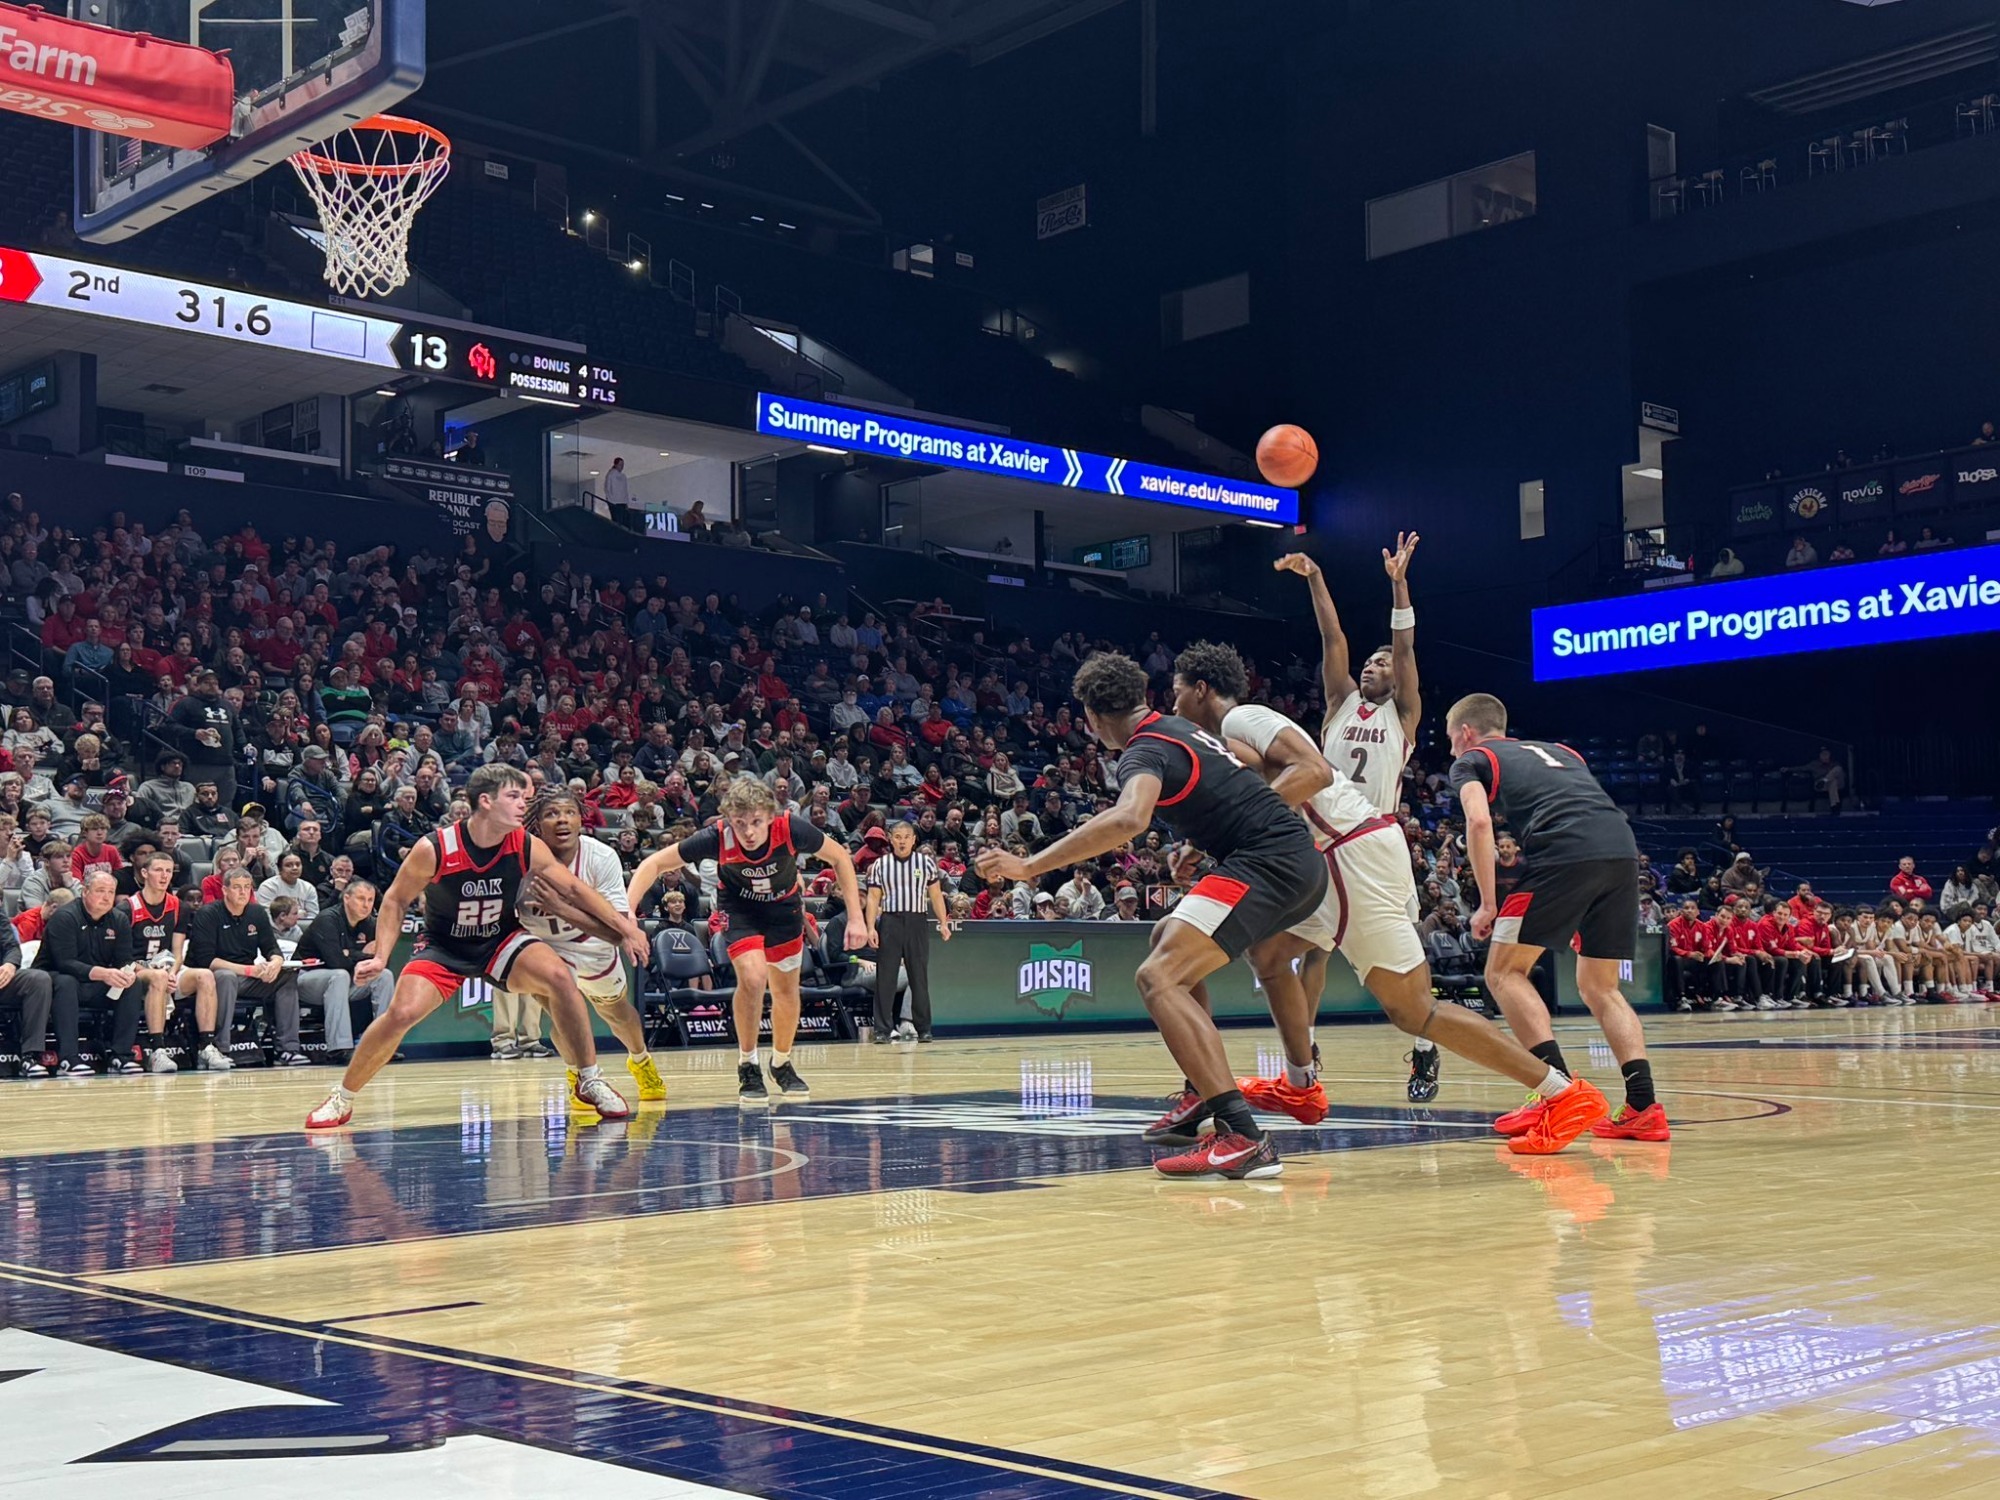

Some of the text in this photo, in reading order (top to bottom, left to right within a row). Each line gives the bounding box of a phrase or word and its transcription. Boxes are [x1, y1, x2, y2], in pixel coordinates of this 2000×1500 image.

[0, 26, 97, 86] Farm
[0, 87, 83, 117] Sta
[68, 269, 120, 301] 2nd
[176, 289, 271, 336] 31.6
[411, 333, 448, 370] 13
[534, 356, 617, 383] BONUS 4 TOL
[510, 372, 616, 402] POSSESSION 3 FLS
[768, 402, 1050, 474] Summer Programs at Xavier
[188, 467, 206, 476] 109
[1958, 467, 1999, 484] noosa
[428, 489, 482, 507] REPUBLIC
[1140, 475, 1280, 512] xavier.edu/summer
[452, 520, 481, 530] DCAST
[1552, 574, 2000, 657] Summer Programs at Xavie
[1350, 747, 1368, 784] 2
[1519, 745, 1564, 768] 1
[741, 862, 779, 878] OAK
[461, 878, 503, 897] OAK
[751, 878, 773, 894] 2
[457, 899, 503, 927] 22
[143, 926, 166, 937] OAK
[401, 919, 425, 933] an
[1019, 959, 1091, 994] OHSAA
[686, 1020, 727, 1033] FENIX
[854, 1016, 874, 1027] FEN
[229, 1042, 258, 1051] YOTA
